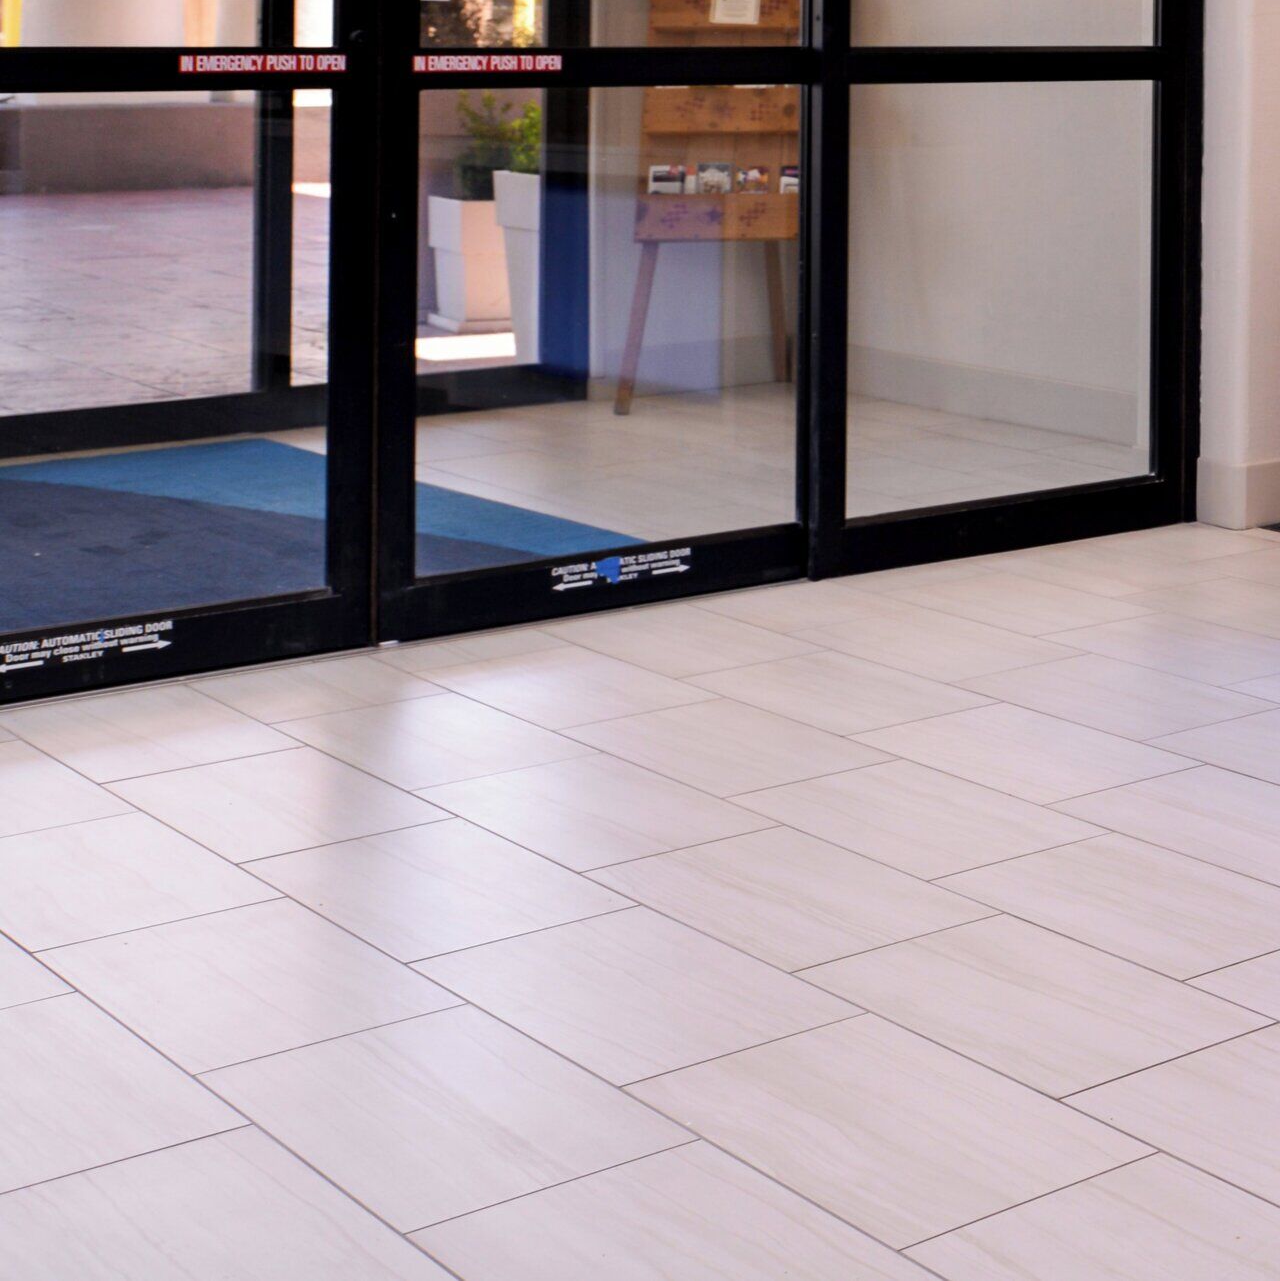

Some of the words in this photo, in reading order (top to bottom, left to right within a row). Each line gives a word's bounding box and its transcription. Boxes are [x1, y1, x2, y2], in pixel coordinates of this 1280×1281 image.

[181, 55, 194, 72] IN
[196, 55, 264, 72] EMERGENCY
[266, 55, 296, 72] PUSH
[300, 55, 314, 72] TO
[317, 55, 346, 72] OPEN
[413, 55, 426, 71] IN
[428, 55, 488, 71] EMERGENCY
[490, 55, 518, 71] PUSH
[520, 55, 533, 71] TO
[535, 55, 562, 71] OPEN
[0, 641, 39, 655] AUTION:
[41, 630, 101, 649] AUTOMATIC
[103, 625, 143, 640] SLIDING
[145, 620, 173, 634] DOOR
[5, 652, 29, 663] Door
[30, 649, 52, 661] may
[53, 645, 80, 656] close
[81, 639, 119, 652] without
[119, 633, 160, 647] warning
[62, 650, 104, 664] STANLEY
